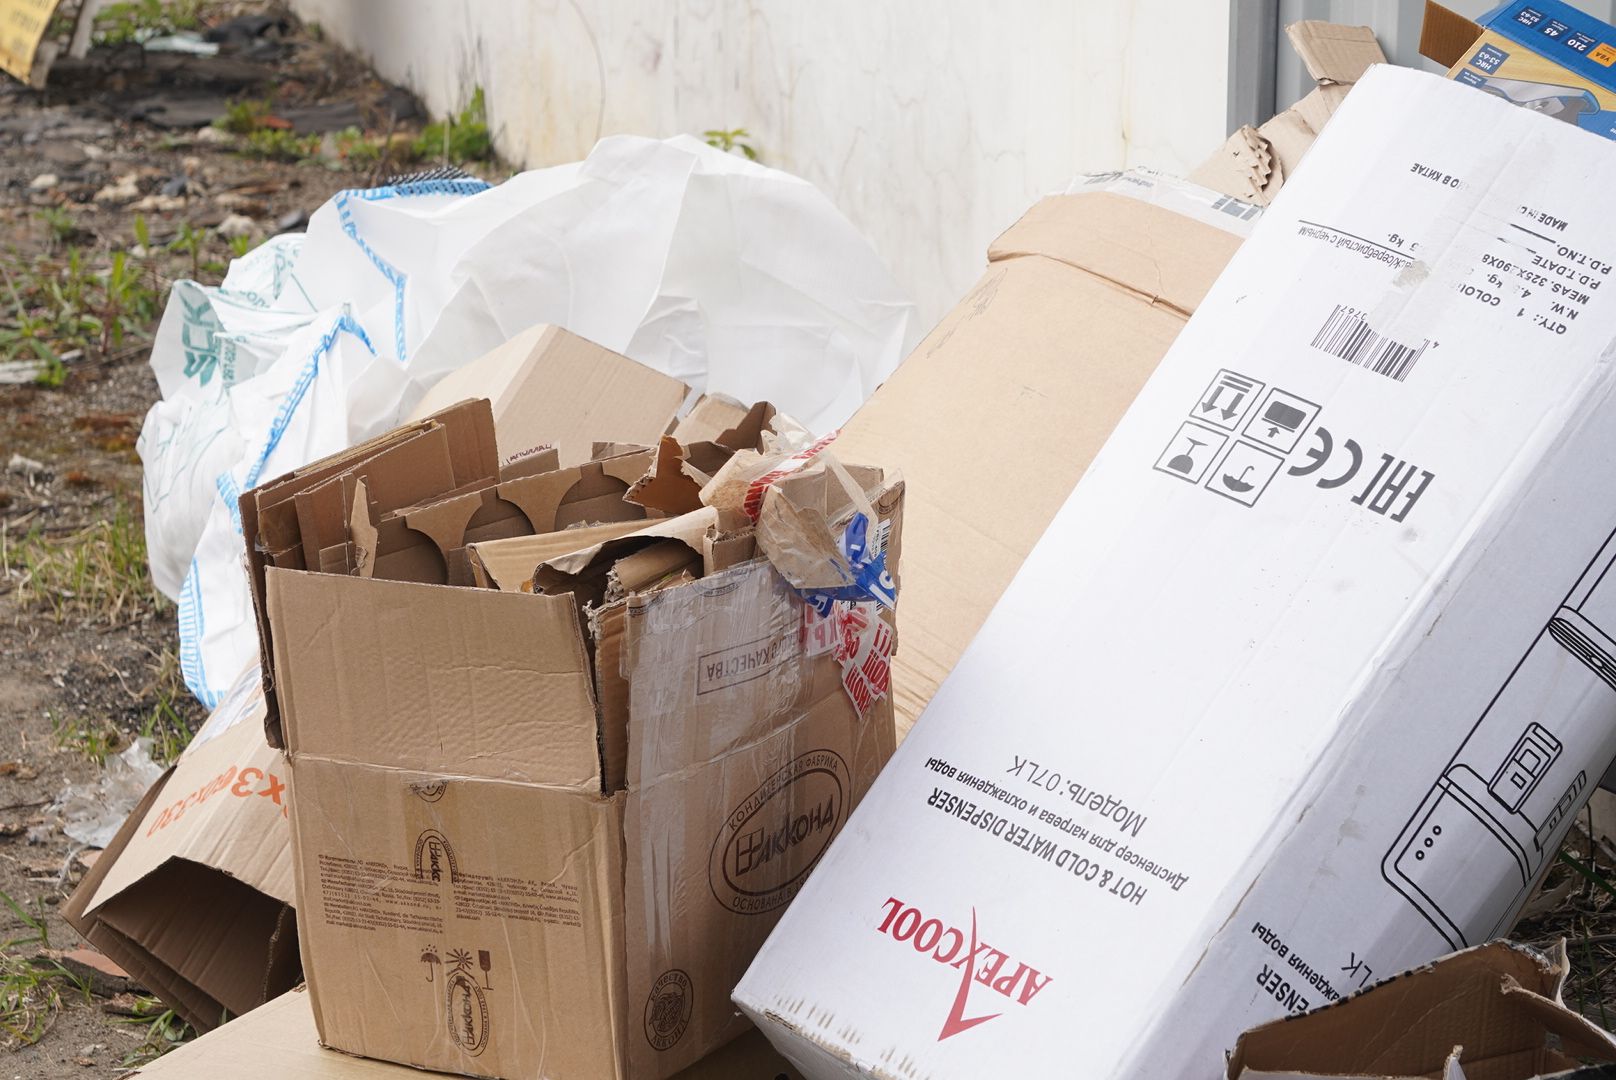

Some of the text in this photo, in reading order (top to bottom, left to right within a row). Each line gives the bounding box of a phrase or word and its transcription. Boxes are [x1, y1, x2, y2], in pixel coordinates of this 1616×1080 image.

[1544, 28, 1559, 37] 45
[1567, 39, 1588, 51] 210
[1475, 59, 1492, 70] HRC
[1410, 162, 1442, 181] КИТАЕ
[1538, 213, 1568, 231] MADE
[1299, 226, 1330, 242] черным
[1388, 233, 1404, 248] kg.
[1551, 281, 1591, 305] MEAS.
[1516, 308, 1525, 317] 1
[1550, 301, 1579, 320] N.W.
[806, 755, 838, 772] ФАБРИКА
[1006, 755, 1147, 837] Модель: 07LK
[925, 757, 1189, 891] Диспенсер для нагрева и охлаждения воды
[927, 787, 1147, 905] HOT & COLD WATER DISPENSER
[1251, 922, 1289, 958] воды
[877, 897, 1053, 1041] APEXCOOL
